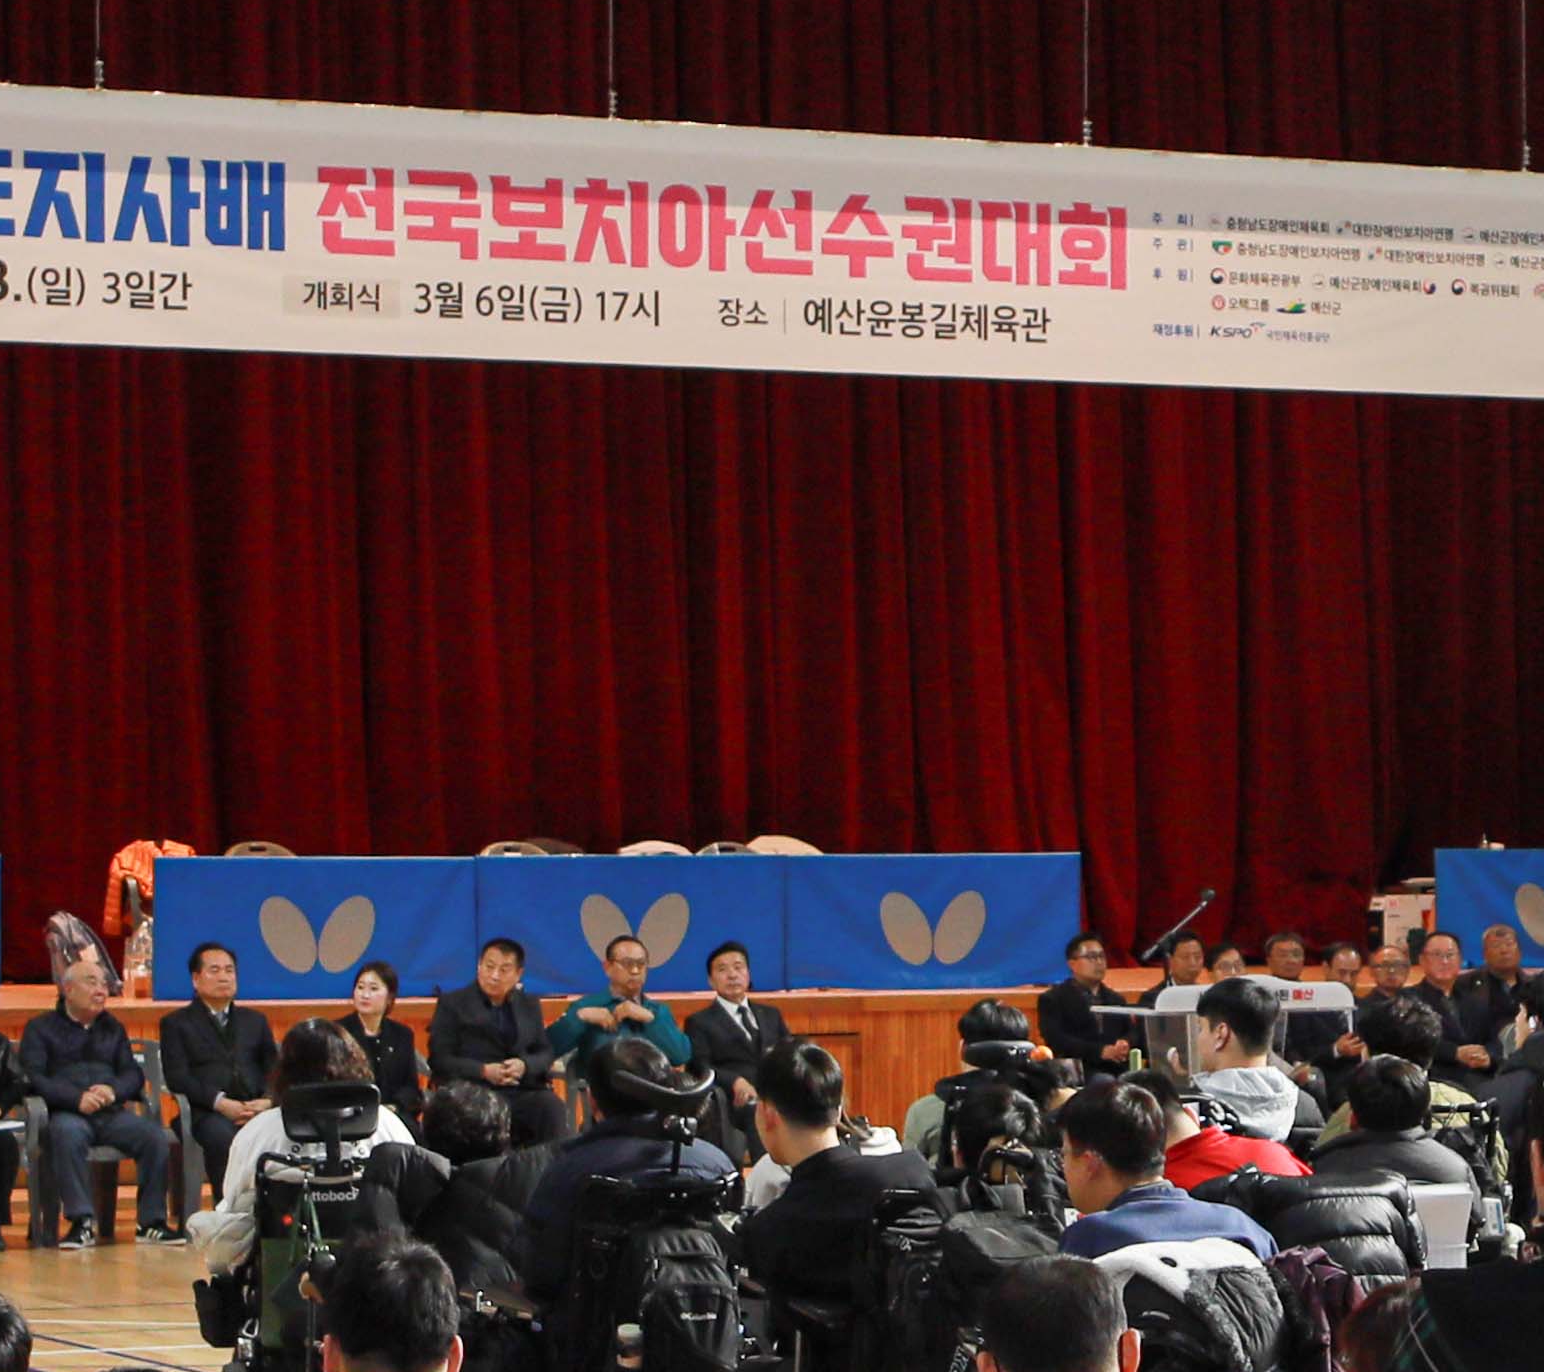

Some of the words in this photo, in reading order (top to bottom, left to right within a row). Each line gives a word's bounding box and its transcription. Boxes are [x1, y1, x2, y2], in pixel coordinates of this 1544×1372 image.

[316, 165, 1127, 291] 전국보치아선수권대회
[102, 271, 193, 311] 3일간
[302, 281, 381, 313] 개회식
[413, 282, 464, 319] 3월
[475, 284, 584, 325] 6일(금)
[596, 289, 661, 327] 17시
[717, 297, 770, 327] 장소
[802, 296, 1052, 344] 예산윤봉길체육관
[1210, 325, 1253, 339] KSPO
